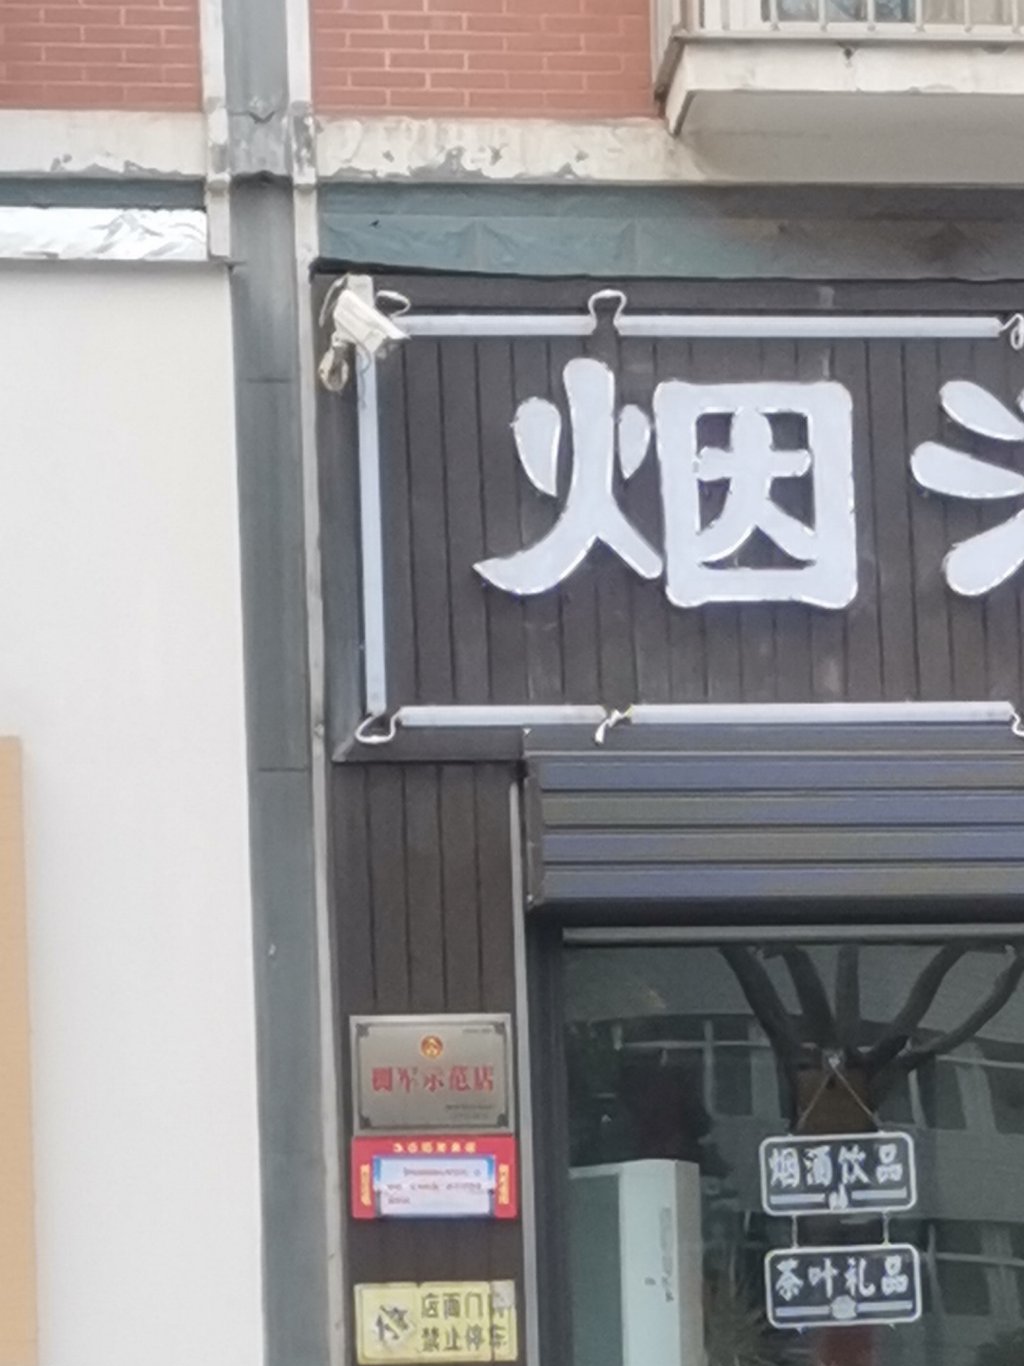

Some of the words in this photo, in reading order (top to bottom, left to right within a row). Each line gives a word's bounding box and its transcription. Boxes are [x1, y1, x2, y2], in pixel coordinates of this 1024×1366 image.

[768, 1143, 904, 1188] 烟酒饮品
[775, 1255, 909, 1301] 茶叶礼品
